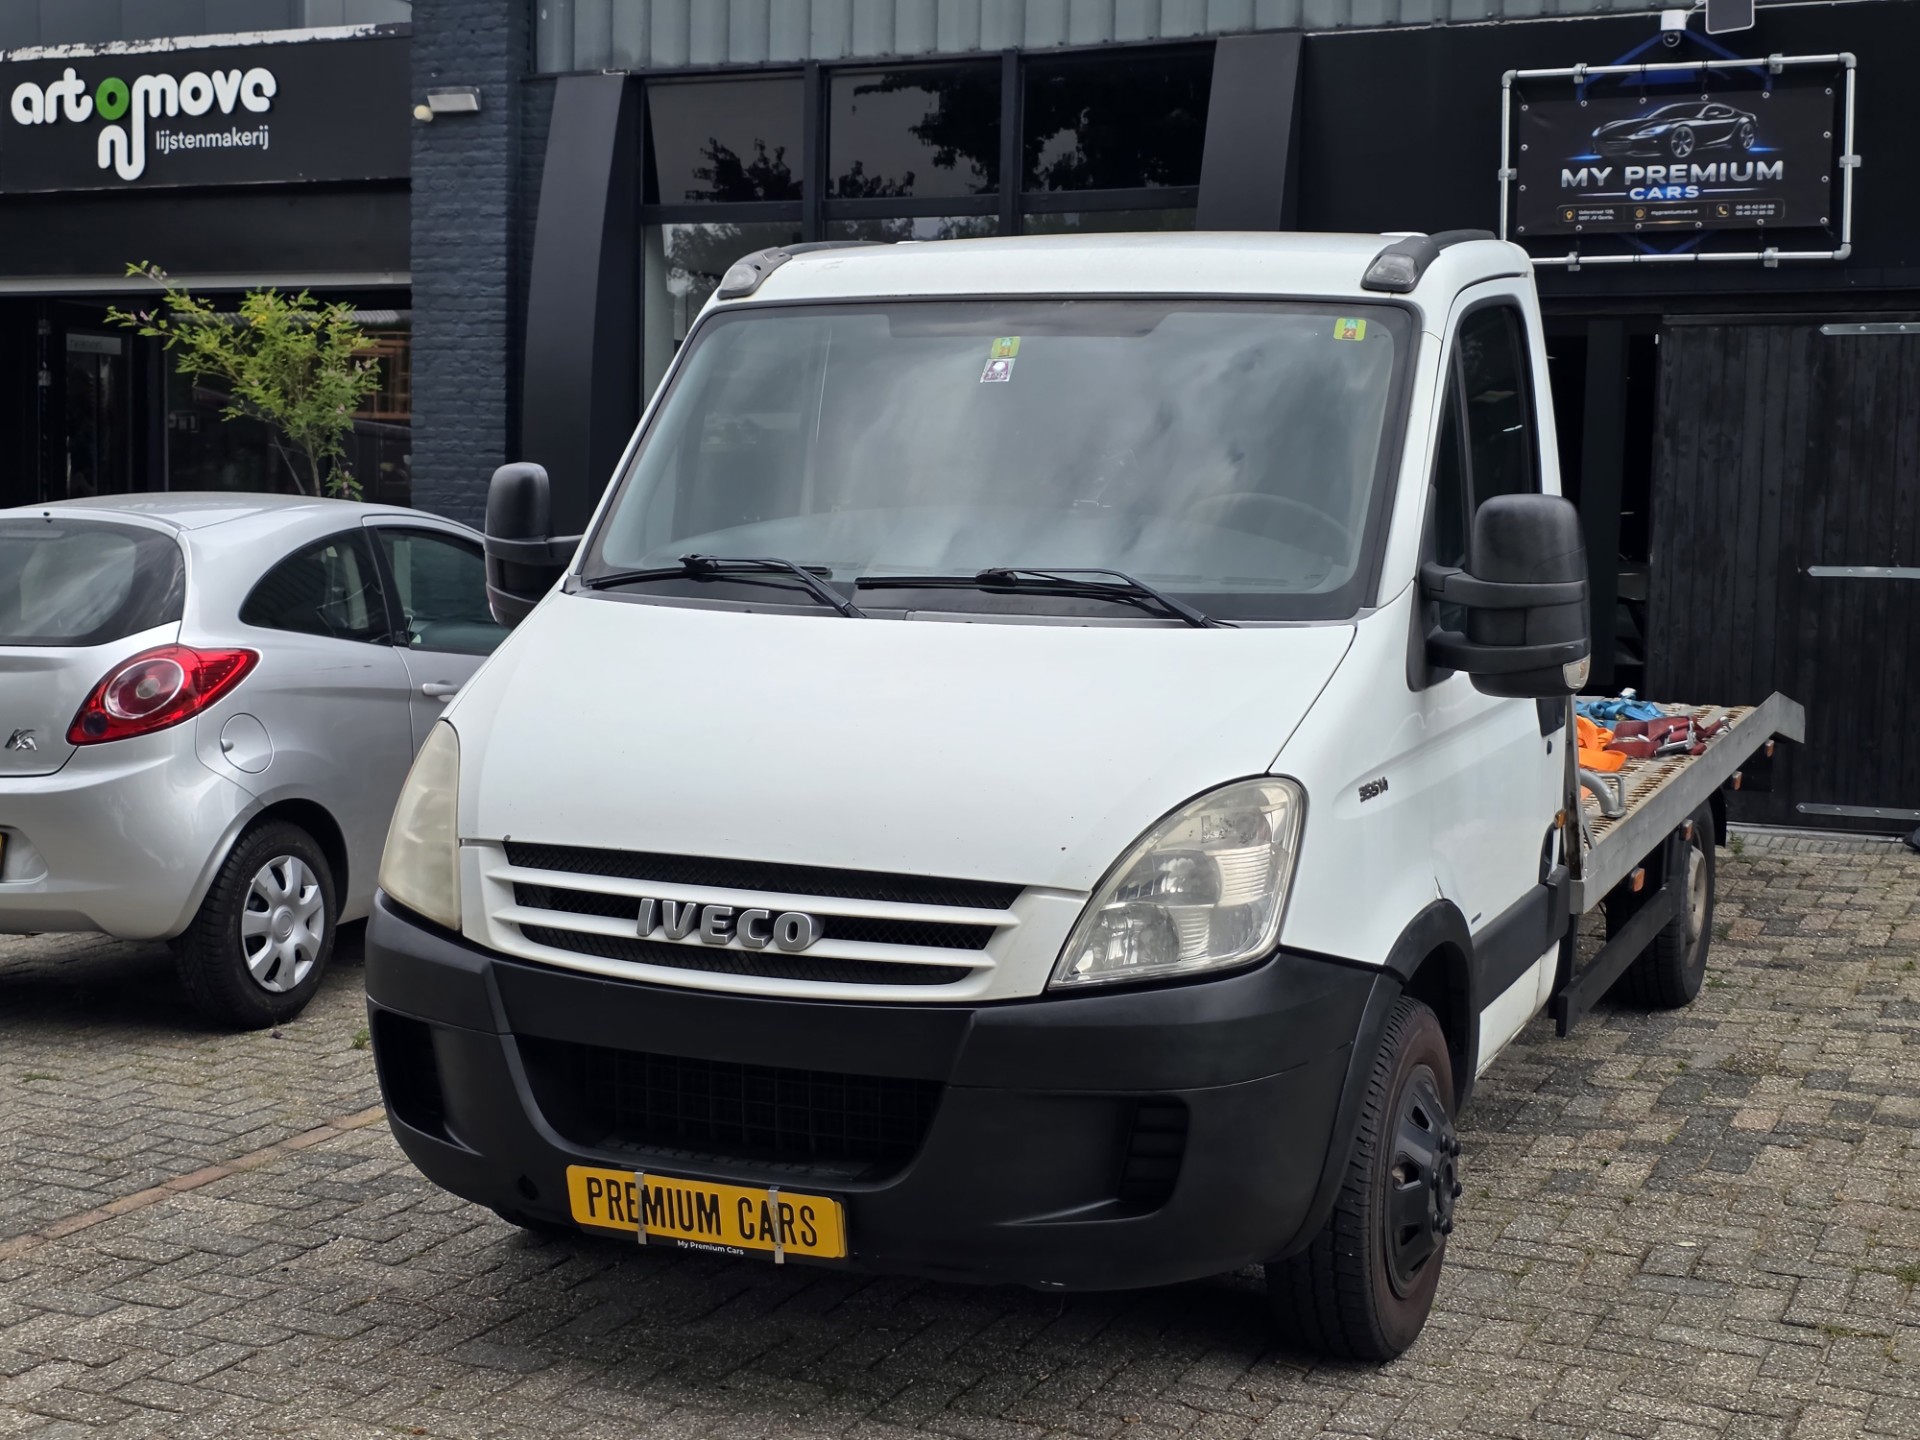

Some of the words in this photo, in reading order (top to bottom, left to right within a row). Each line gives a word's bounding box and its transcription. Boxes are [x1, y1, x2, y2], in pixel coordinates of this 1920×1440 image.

[155, 126, 269, 154] lijstenmakerij
[1561, 167, 1613, 187] MY
[1624, 160, 1784, 185] PREMIUM
[1629, 185, 1700, 200] CARS
[636, 898, 825, 952] IVECO
[586, 1176, 722, 1236] PREMIUM
[737, 1196, 818, 1247] CARS
[677, 1240, 689, 1249] My
[690, 1242, 725, 1253] Premium
[726, 1246, 744, 1255] Cars
